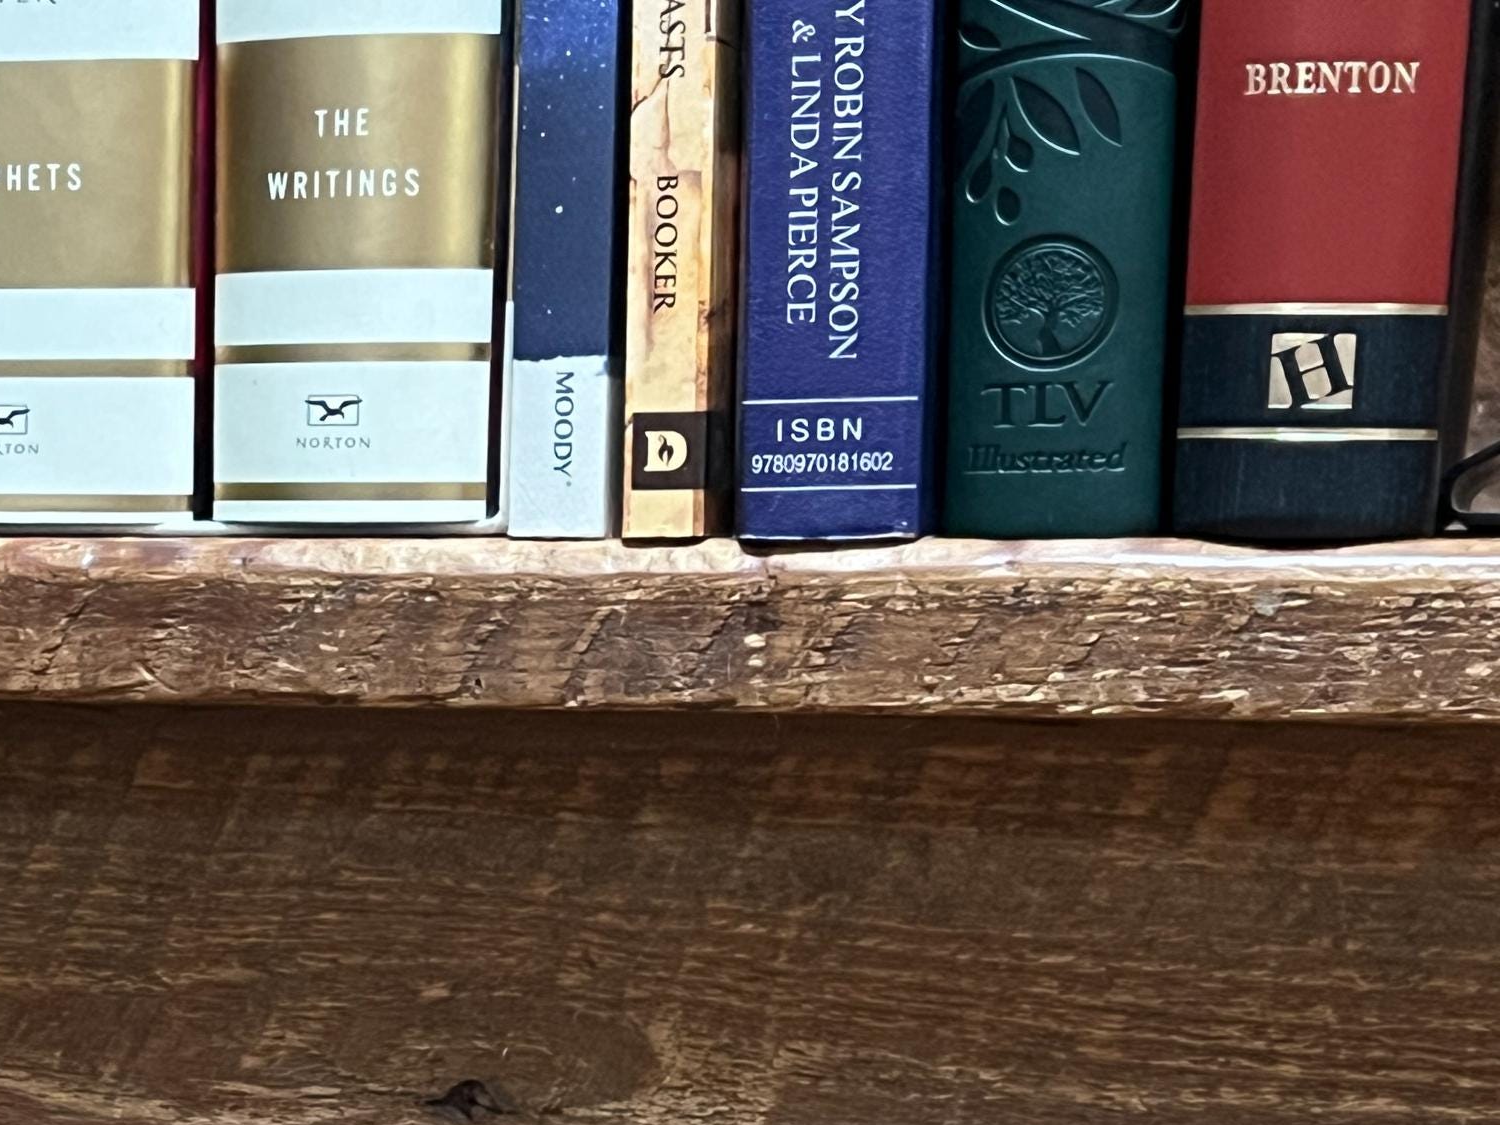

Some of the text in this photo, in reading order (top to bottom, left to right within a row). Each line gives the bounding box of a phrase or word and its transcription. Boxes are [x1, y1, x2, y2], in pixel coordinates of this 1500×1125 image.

[657, 0, 686, 79] ASTS
[832, 35, 865, 162] ROBIN
[1244, 60, 1421, 96] BRENTON
[313, 108, 370, 138] THE
[268, 168, 421, 200] WRITINGS
[786, 19, 822, 325] & LINDA PIERCE
[652, 175, 680, 313] BOOKER
[827, 171, 862, 360] SAMPSON
[553, 371, 576, 478] MOODY
[981, 381, 1115, 429] TLV
[296, 435, 371, 450] NORTON
[776, 417, 865, 442] ISBN
[751, 451, 894, 475] 9780970181602
[964, 441, 1129, 475] Illustrated
